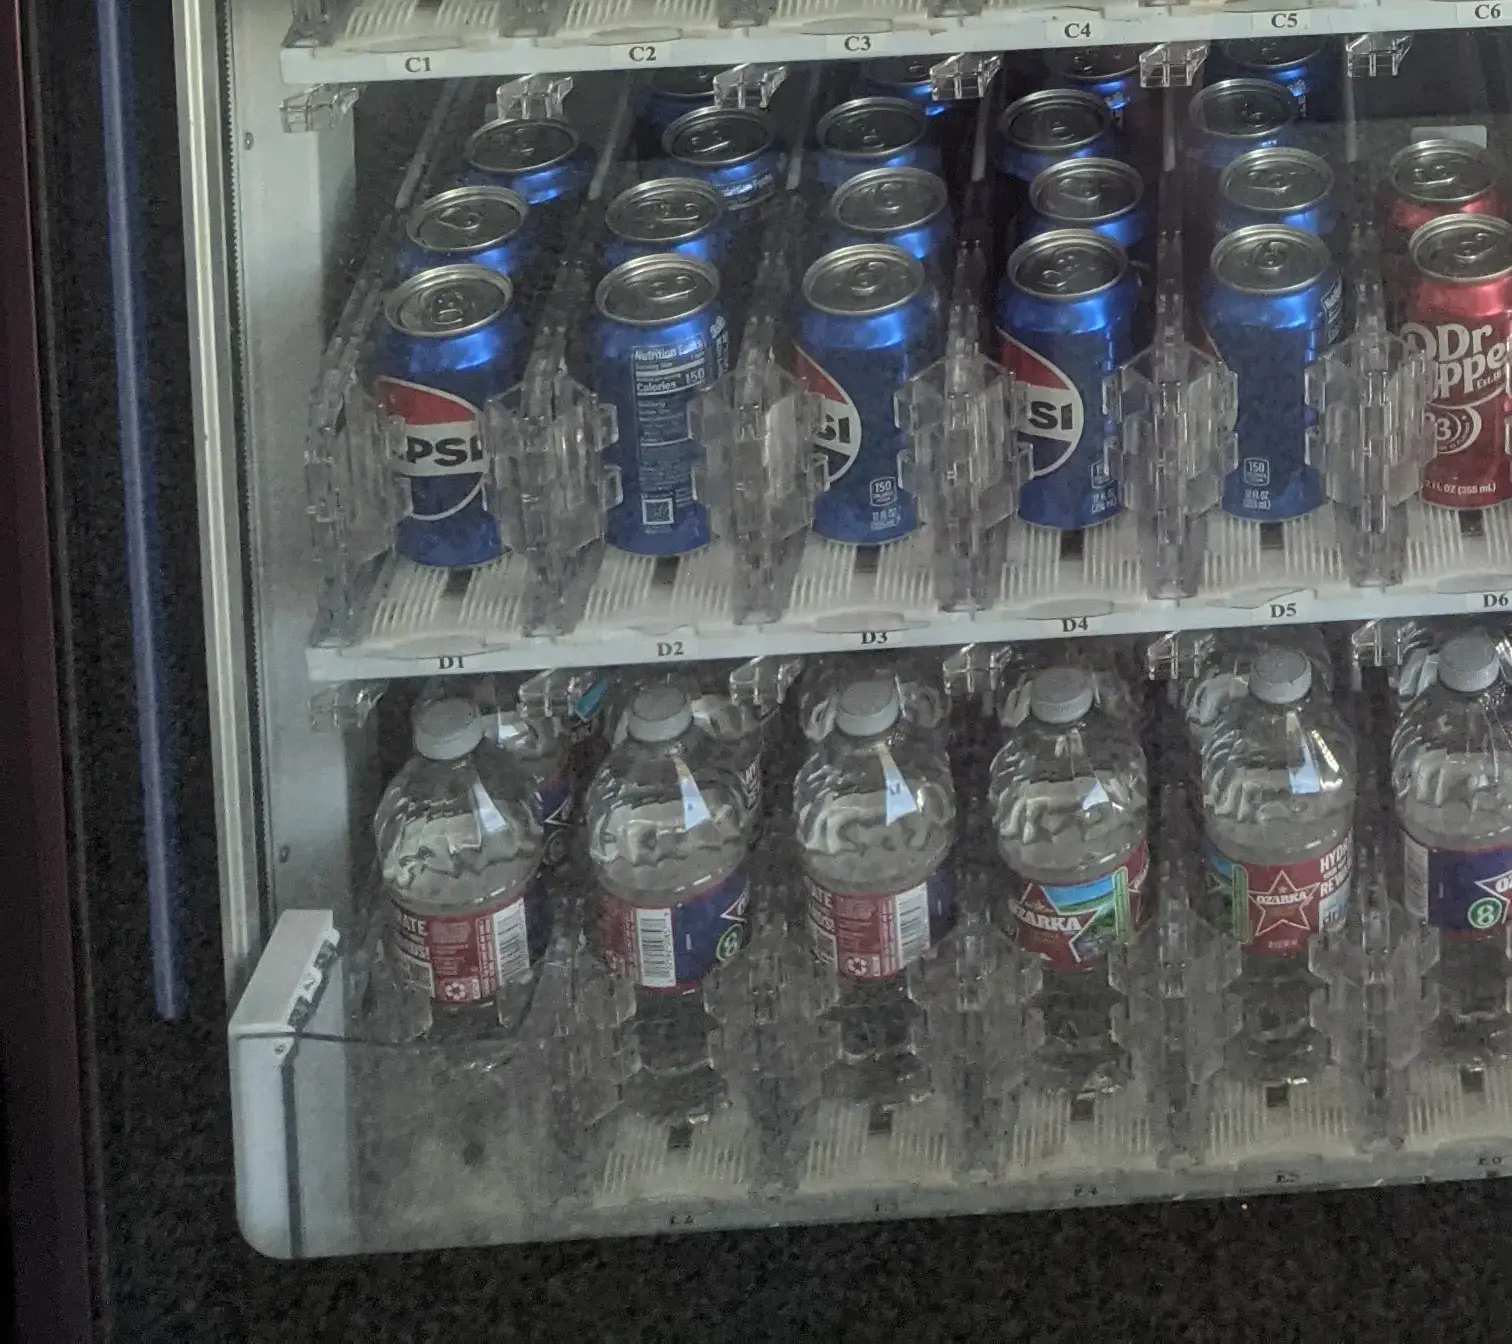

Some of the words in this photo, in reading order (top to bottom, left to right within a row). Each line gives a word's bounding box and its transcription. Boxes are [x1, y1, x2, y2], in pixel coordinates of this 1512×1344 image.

[1270, 11, 1298, 29] C5
[1474, 3, 1502, 20] C6
[1063, 22, 1092, 40] C4
[844, 36, 872, 52] C3
[628, 46, 657, 63] C2
[404, 56, 432, 74] C1
[1437, 323, 1493, 362] Dr
[685, 368, 705, 385] 150
[1482, 592, 1510, 609] D6
[1269, 602, 1297, 619] D5
[1061, 616, 1089, 633] D4
[860, 629, 888, 645] D3
[656, 640, 684, 658] D2
[437, 654, 466, 671] D1
[1477, 903, 1495, 924] 8
